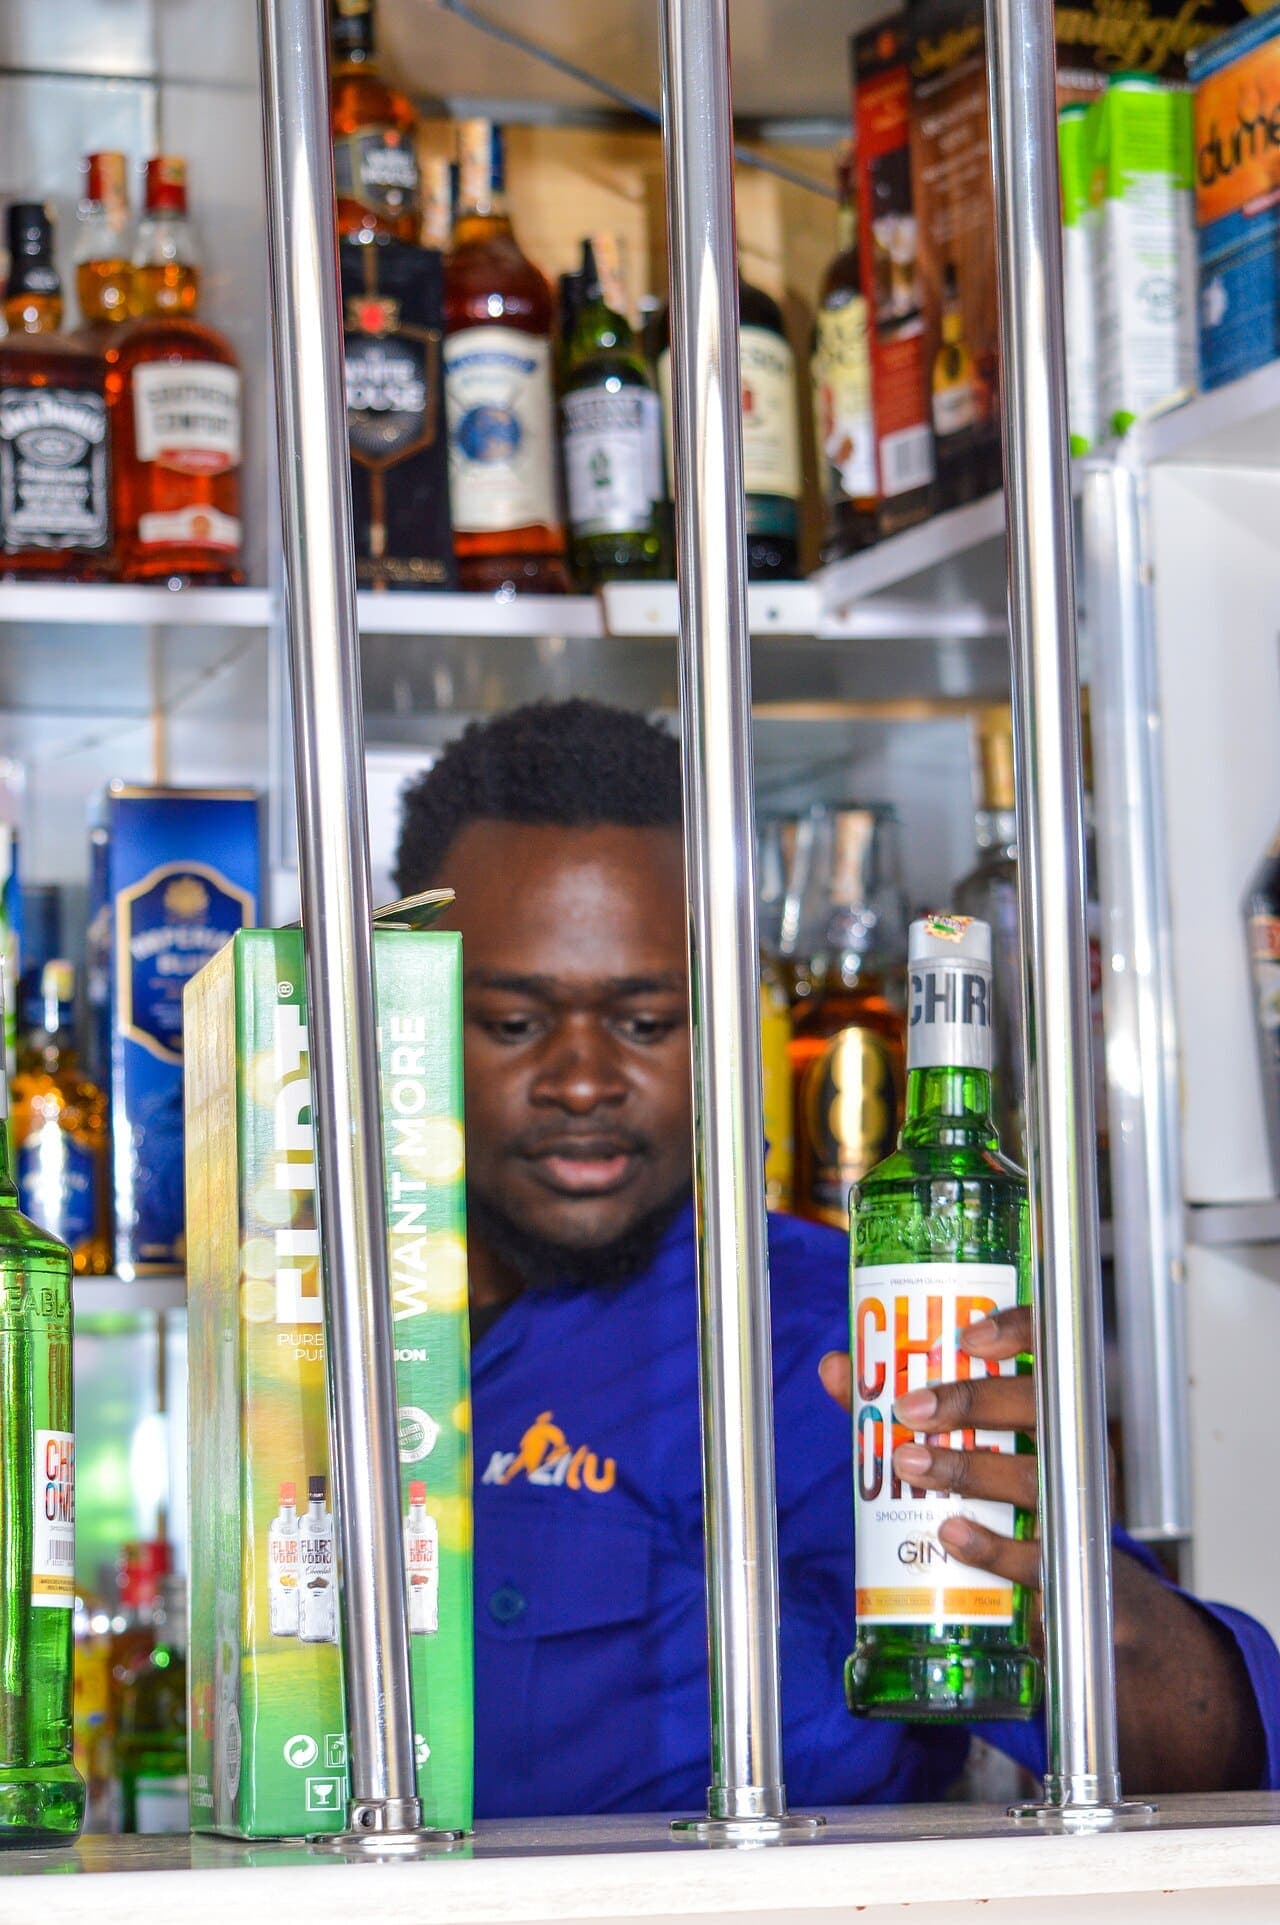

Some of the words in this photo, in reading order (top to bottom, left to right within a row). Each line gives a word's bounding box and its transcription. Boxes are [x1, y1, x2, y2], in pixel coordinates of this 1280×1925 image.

[909, 973, 991, 1028] CHR
[390, 1016, 427, 1155] MORE
[391, 1171, 428, 1322] WANT
[875, 1510, 922, 1521] SMOOTH
[272, 1540, 298, 1553] FLIR
[409, 1539, 433, 1553] LIRT
[897, 1539, 949, 1564] GIN
